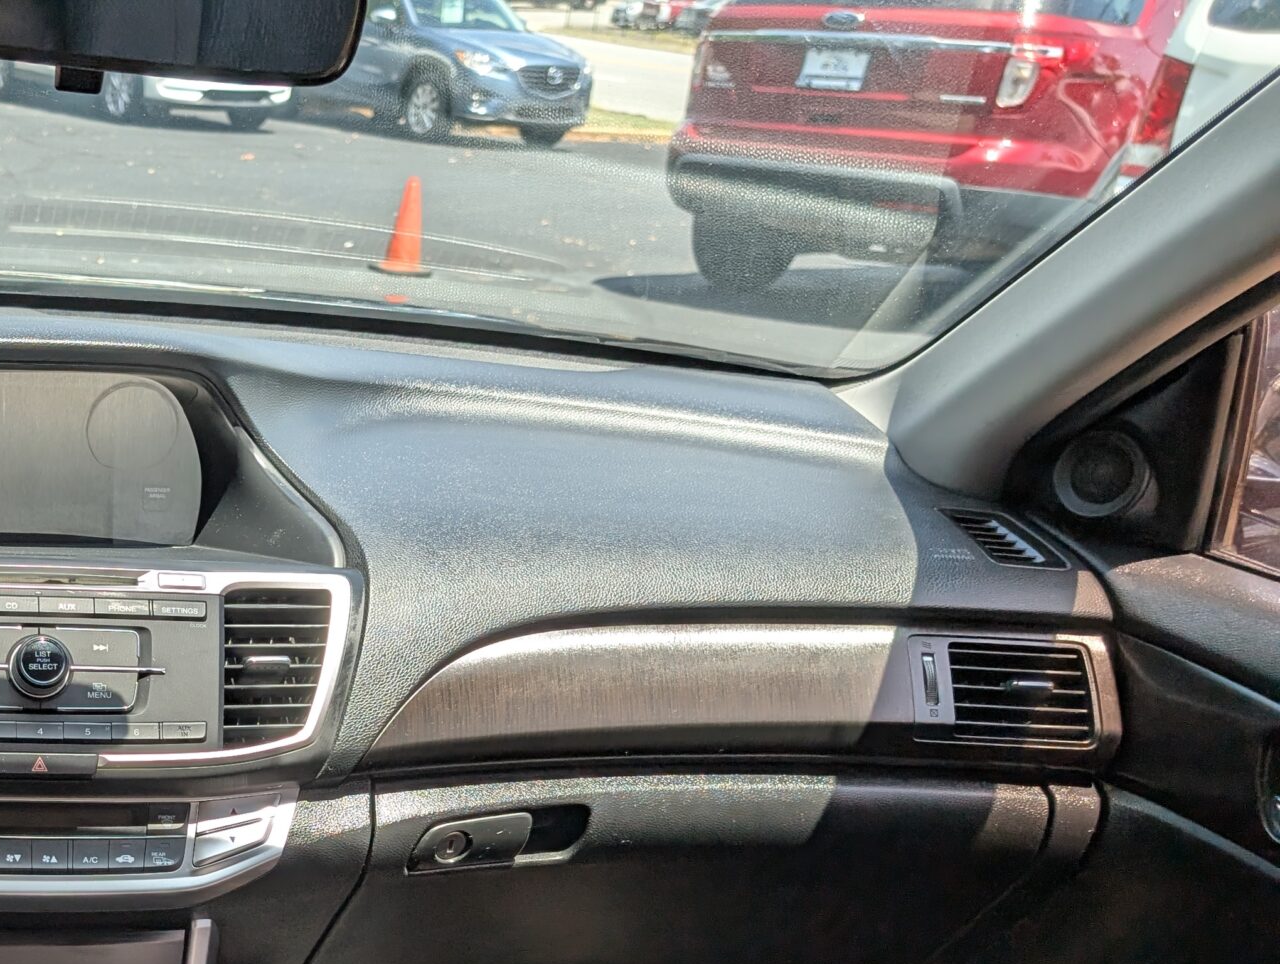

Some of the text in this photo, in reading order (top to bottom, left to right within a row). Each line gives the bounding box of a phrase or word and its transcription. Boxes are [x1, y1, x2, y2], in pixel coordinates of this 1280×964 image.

[58, 603, 76, 611] AUX
[108, 605, 137, 613] PHONE
[161, 607, 199, 615] SETTINGS
[85, 728, 91, 736] 5
